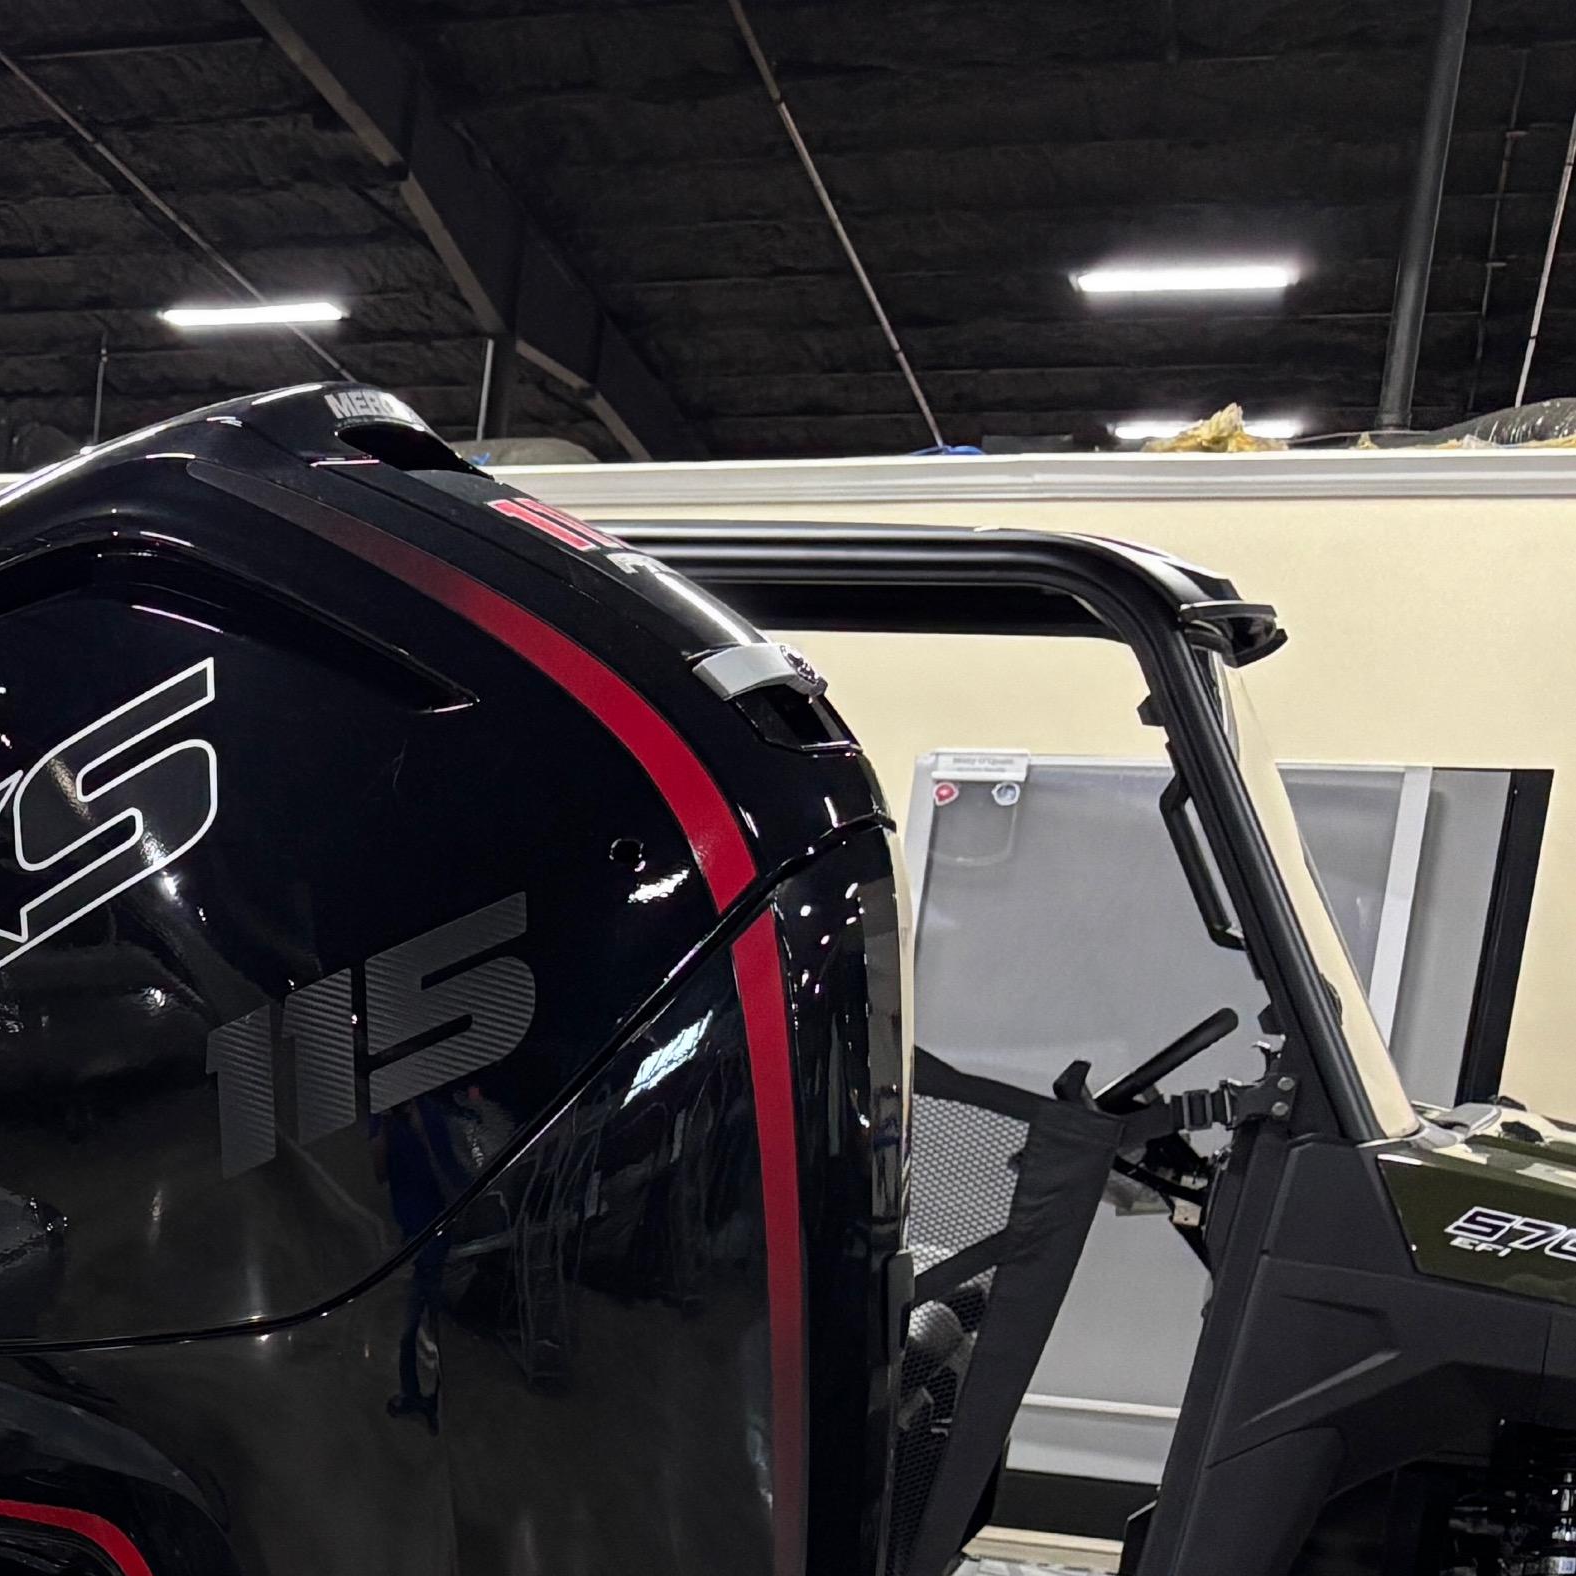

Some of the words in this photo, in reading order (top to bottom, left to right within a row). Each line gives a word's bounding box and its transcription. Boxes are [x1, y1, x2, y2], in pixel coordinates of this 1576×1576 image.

[487, 498, 633, 551] 11
[205, 891, 537, 1181] 115
[1449, 1236, 1512, 1257] EFI
